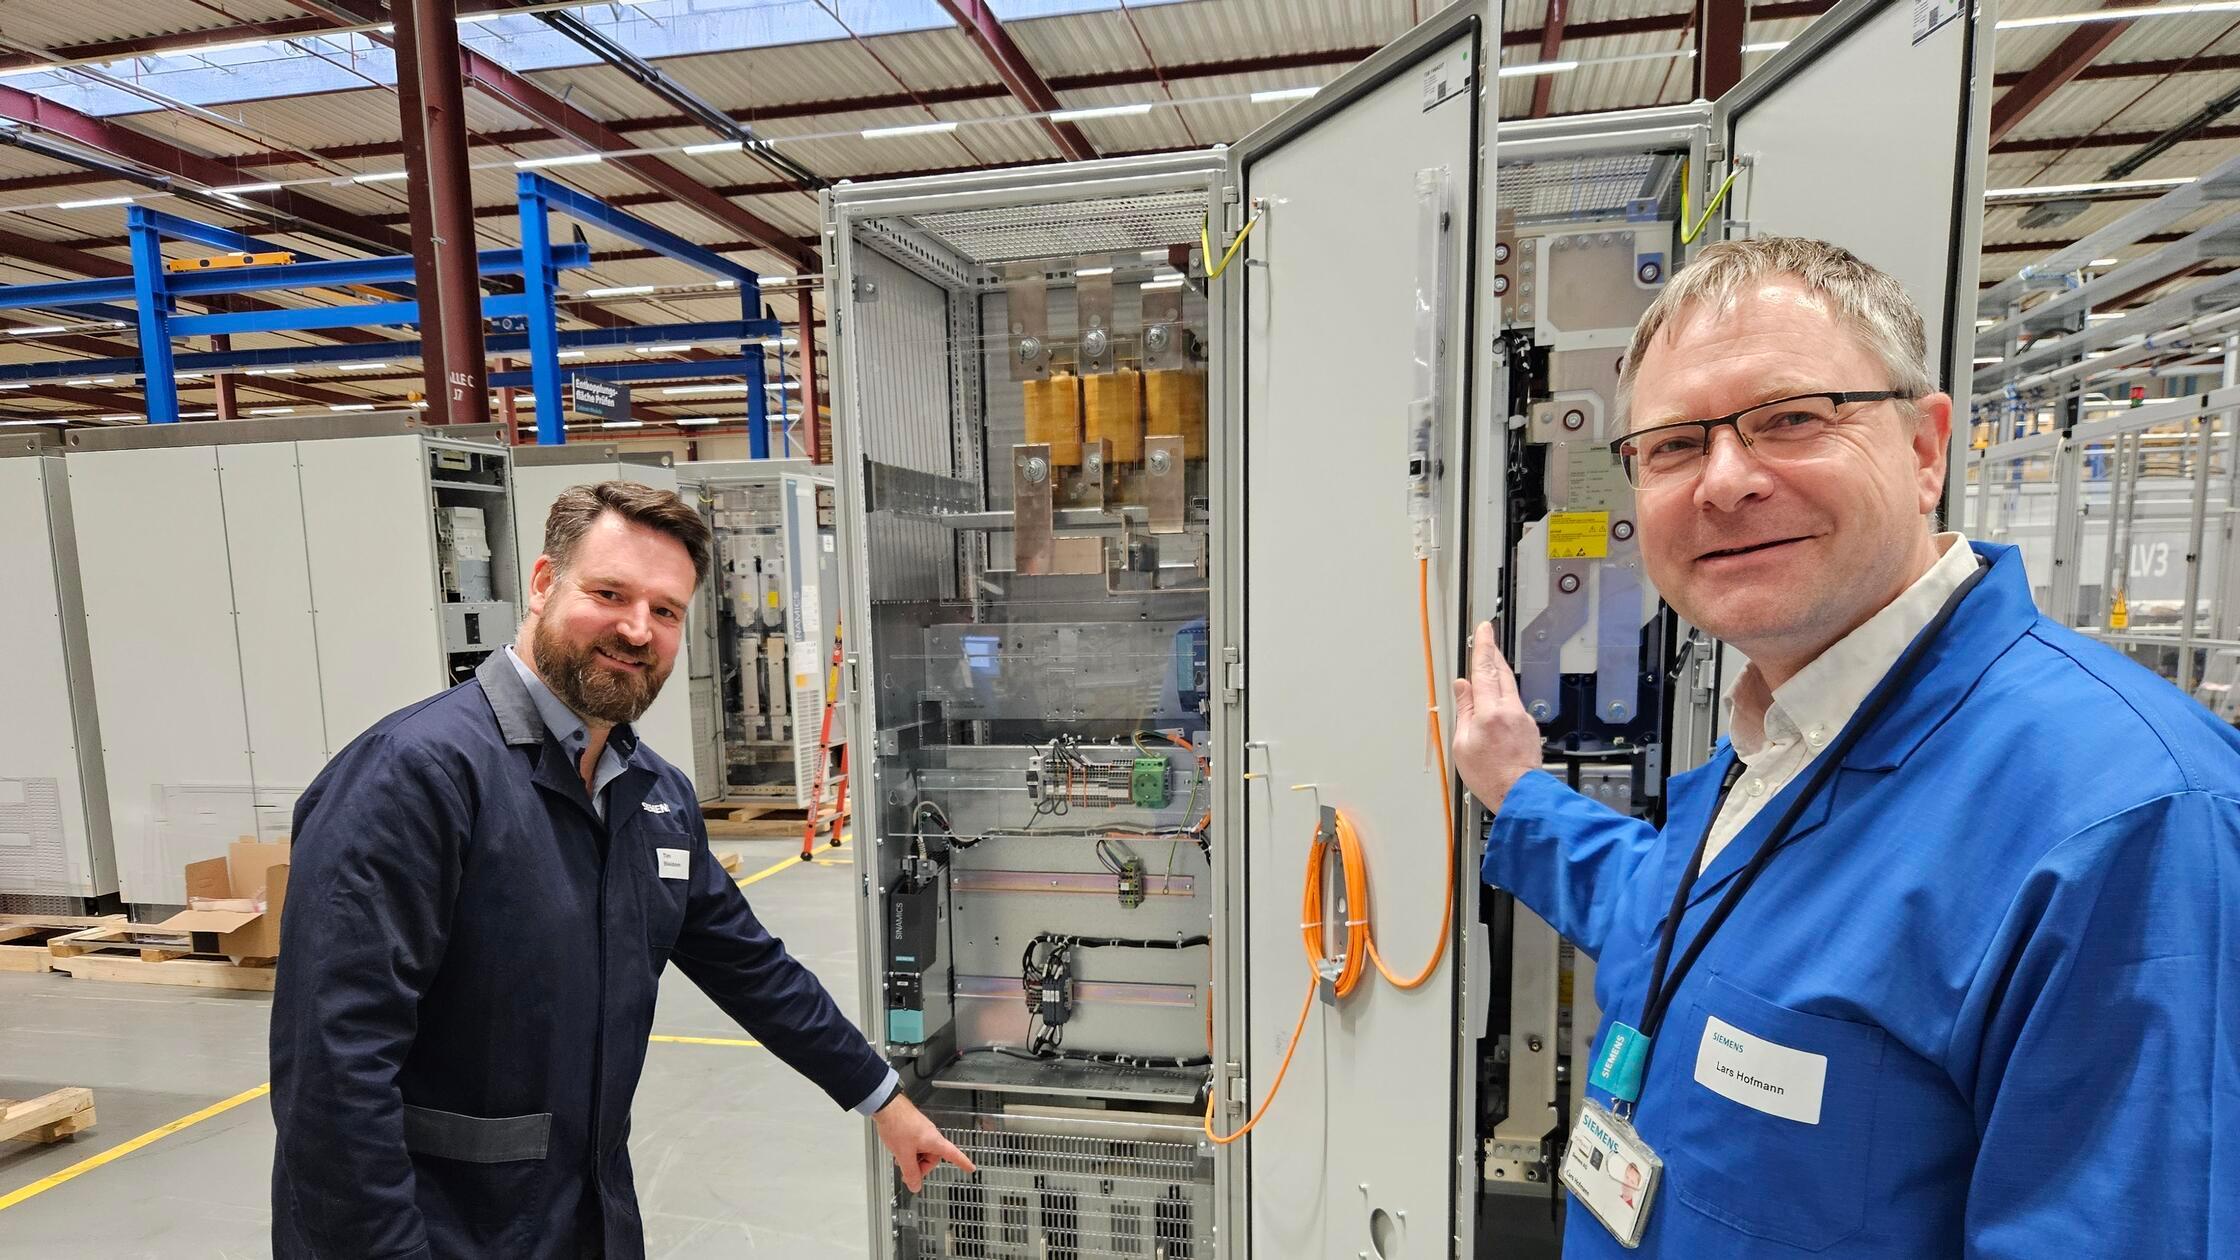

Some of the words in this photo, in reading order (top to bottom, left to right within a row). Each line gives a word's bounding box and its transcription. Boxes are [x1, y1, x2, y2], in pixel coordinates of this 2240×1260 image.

[2130, 542, 2169, 577] LV3
[895, 902, 904, 940] SINAMICS
[1601, 1034, 1625, 1079] SIEMENS
[1712, 1032, 1744, 1054] SIEMENS
[1716, 1060, 1734, 1077] Lars
[1736, 1070, 1785, 1095] Hofmann
[1582, 1114, 1620, 1154] SIEMENS
